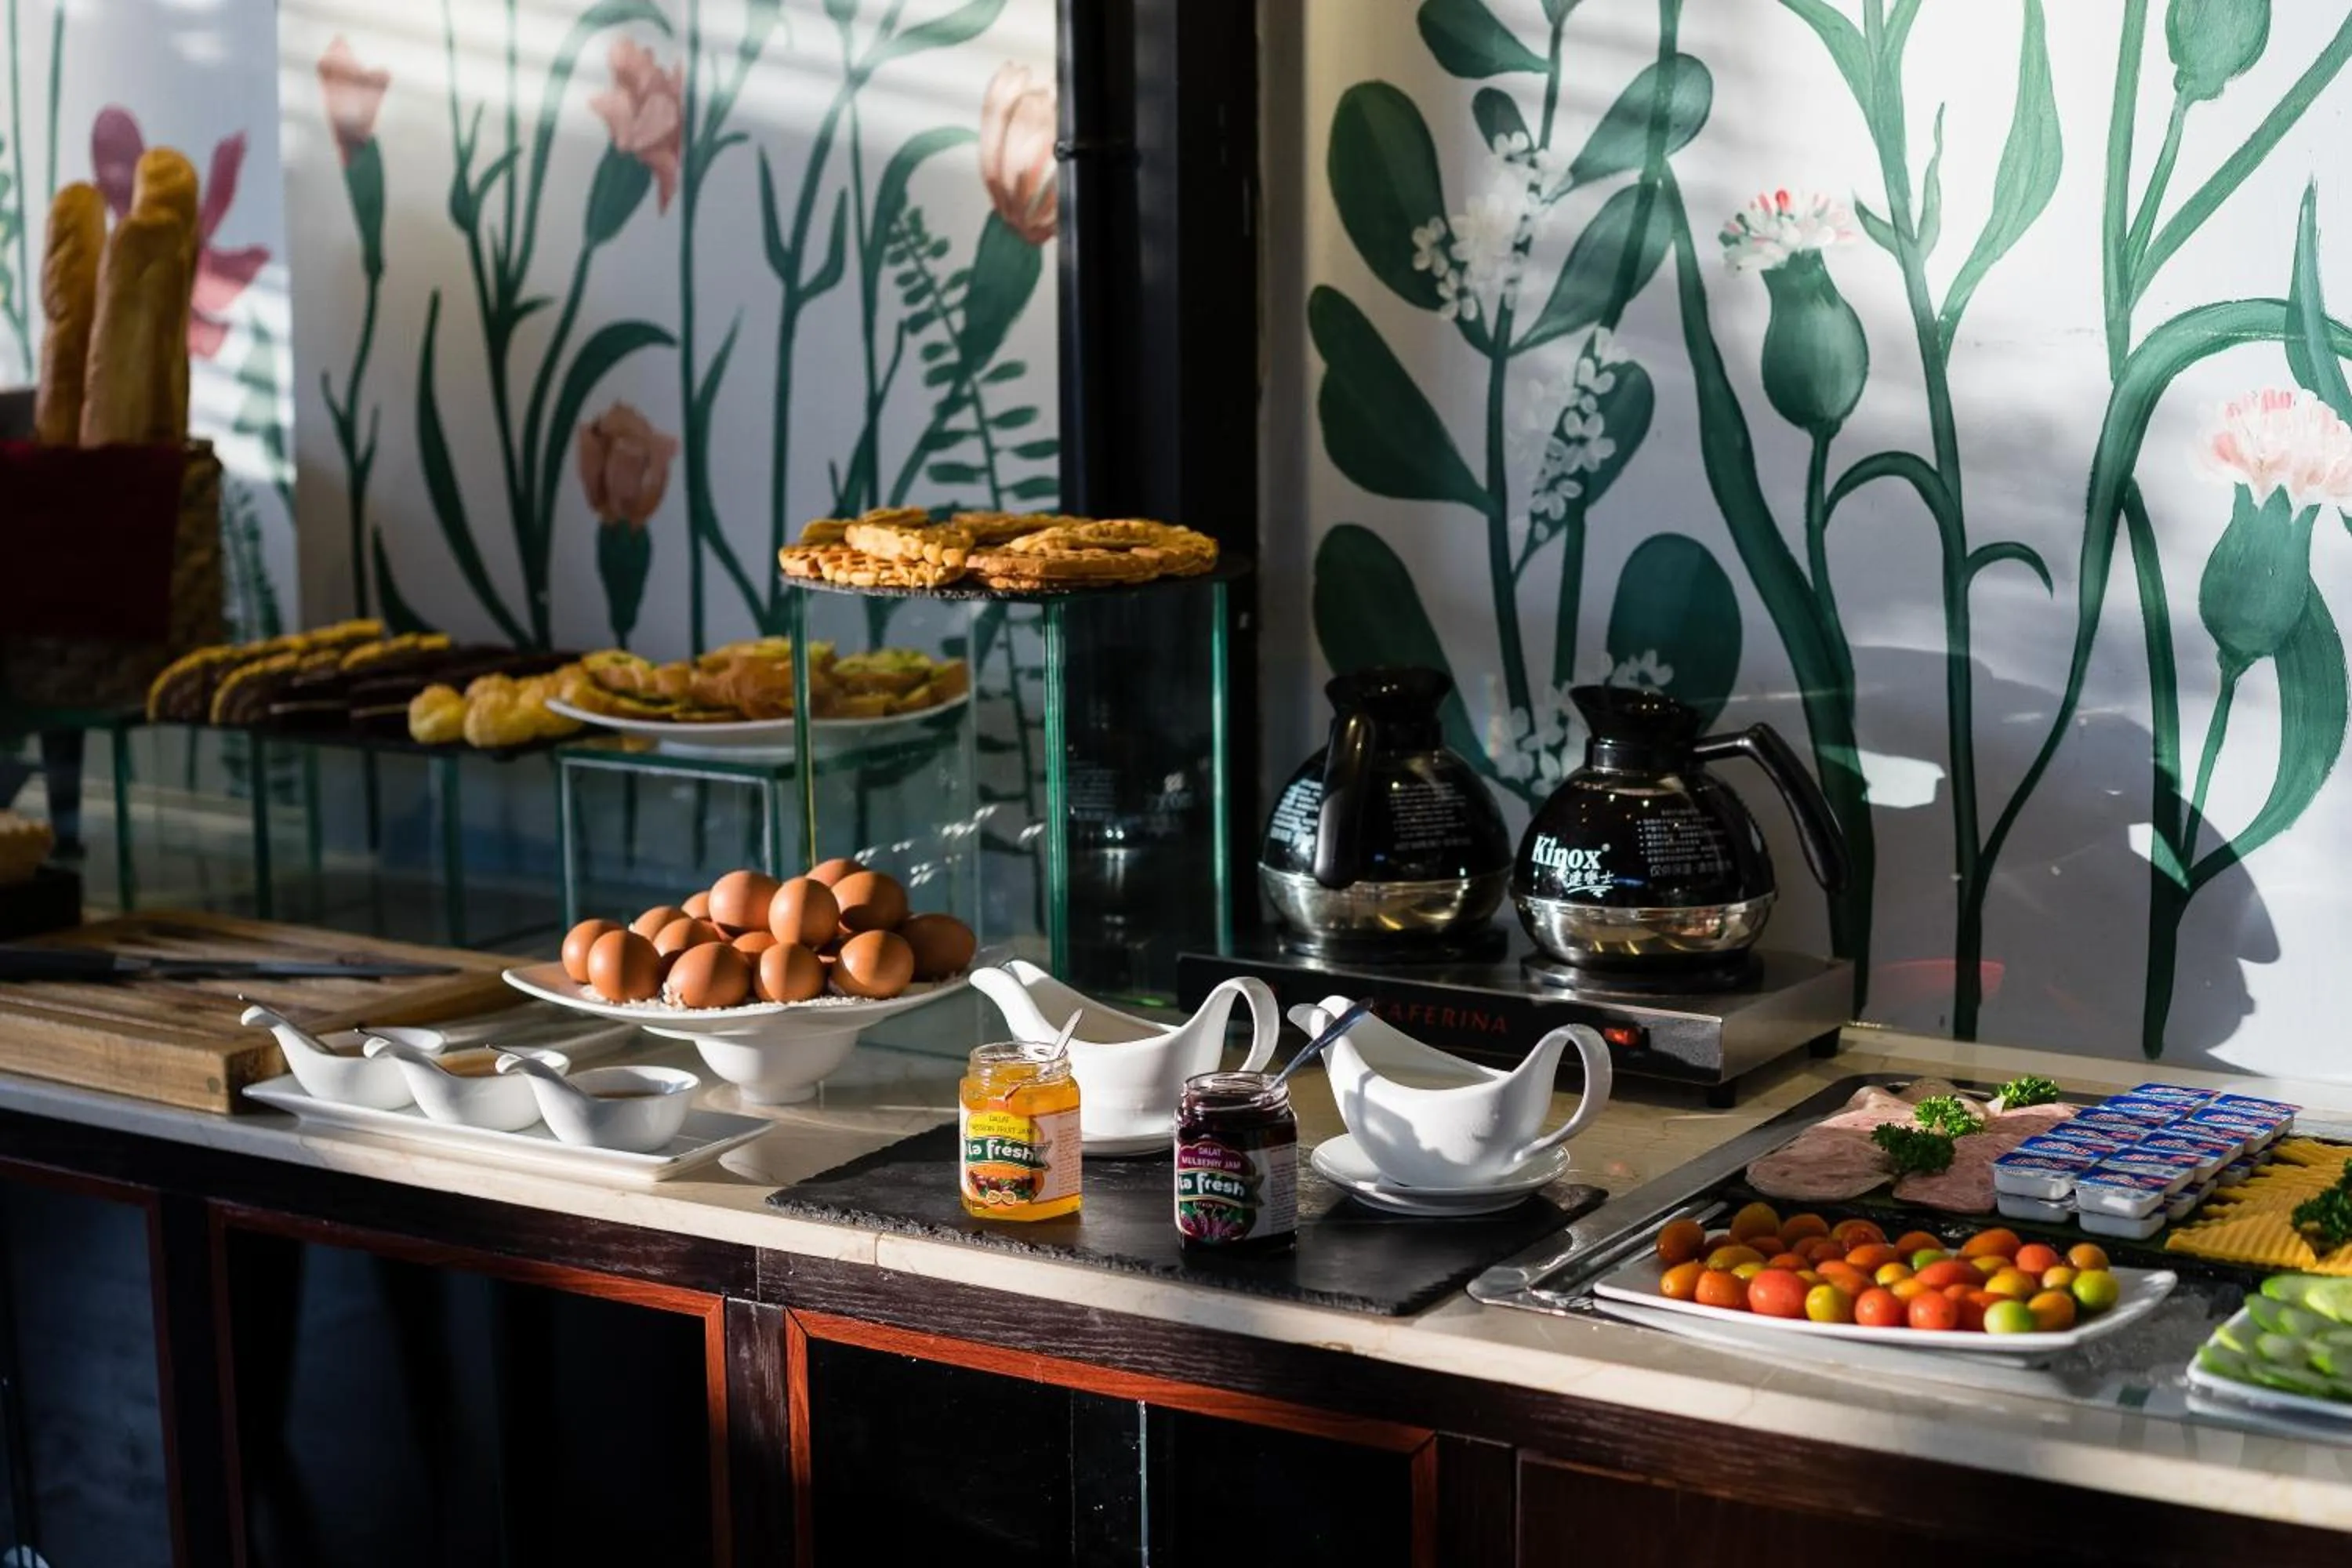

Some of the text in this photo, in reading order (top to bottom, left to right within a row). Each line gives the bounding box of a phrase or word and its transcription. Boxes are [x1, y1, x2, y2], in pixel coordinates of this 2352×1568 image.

[1531, 834, 1602, 869] Kinox
[986, 1139, 1035, 1161] fresh
[1197, 1147, 1222, 1156] DALAT
[1225, 1160, 1242, 1170] JAM
[1196, 1172, 1246, 1197] fresh
